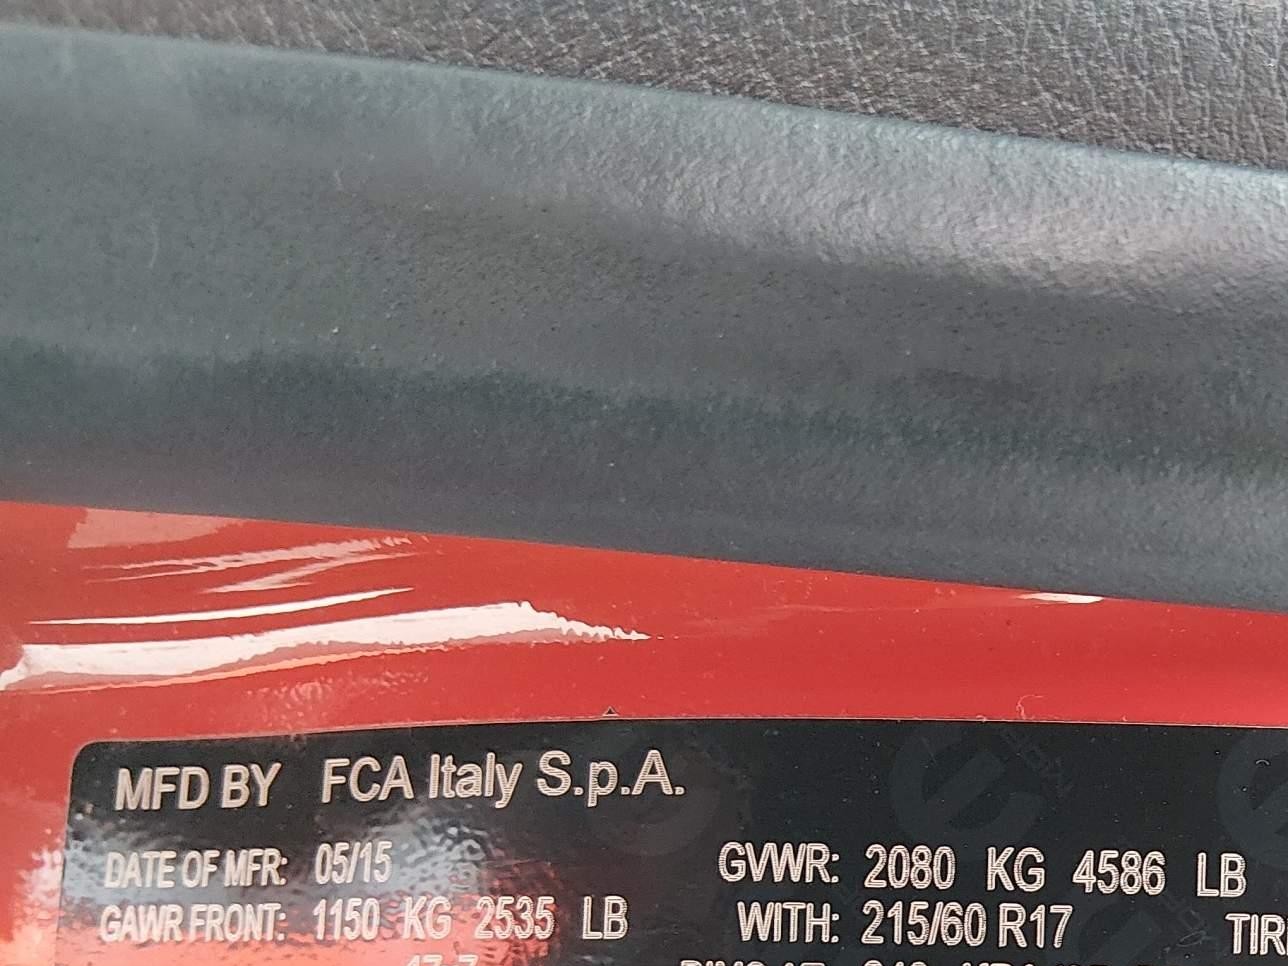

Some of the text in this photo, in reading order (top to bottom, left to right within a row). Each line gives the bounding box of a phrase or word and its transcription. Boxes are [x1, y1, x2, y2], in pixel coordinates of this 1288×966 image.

[115, 749, 686, 810] MFD BY FCA Italy S.p.A.
[104, 841, 393, 888] DATE OF MFR: 05/15
[718, 841, 1247, 898] GVWR: 2080 KG 4586 LB
[102, 904, 183, 942] GAWR
[189, 902, 286, 942] FRONT:
[312, 902, 380, 941] 1150
[403, 899, 453, 939] KG
[475, 897, 555, 939] 2535
[582, 895, 629, 939] LB
[737, 901, 840, 945] WITH:
[861, 900, 986, 947] 215/60
[998, 902, 1073, 949] R17
